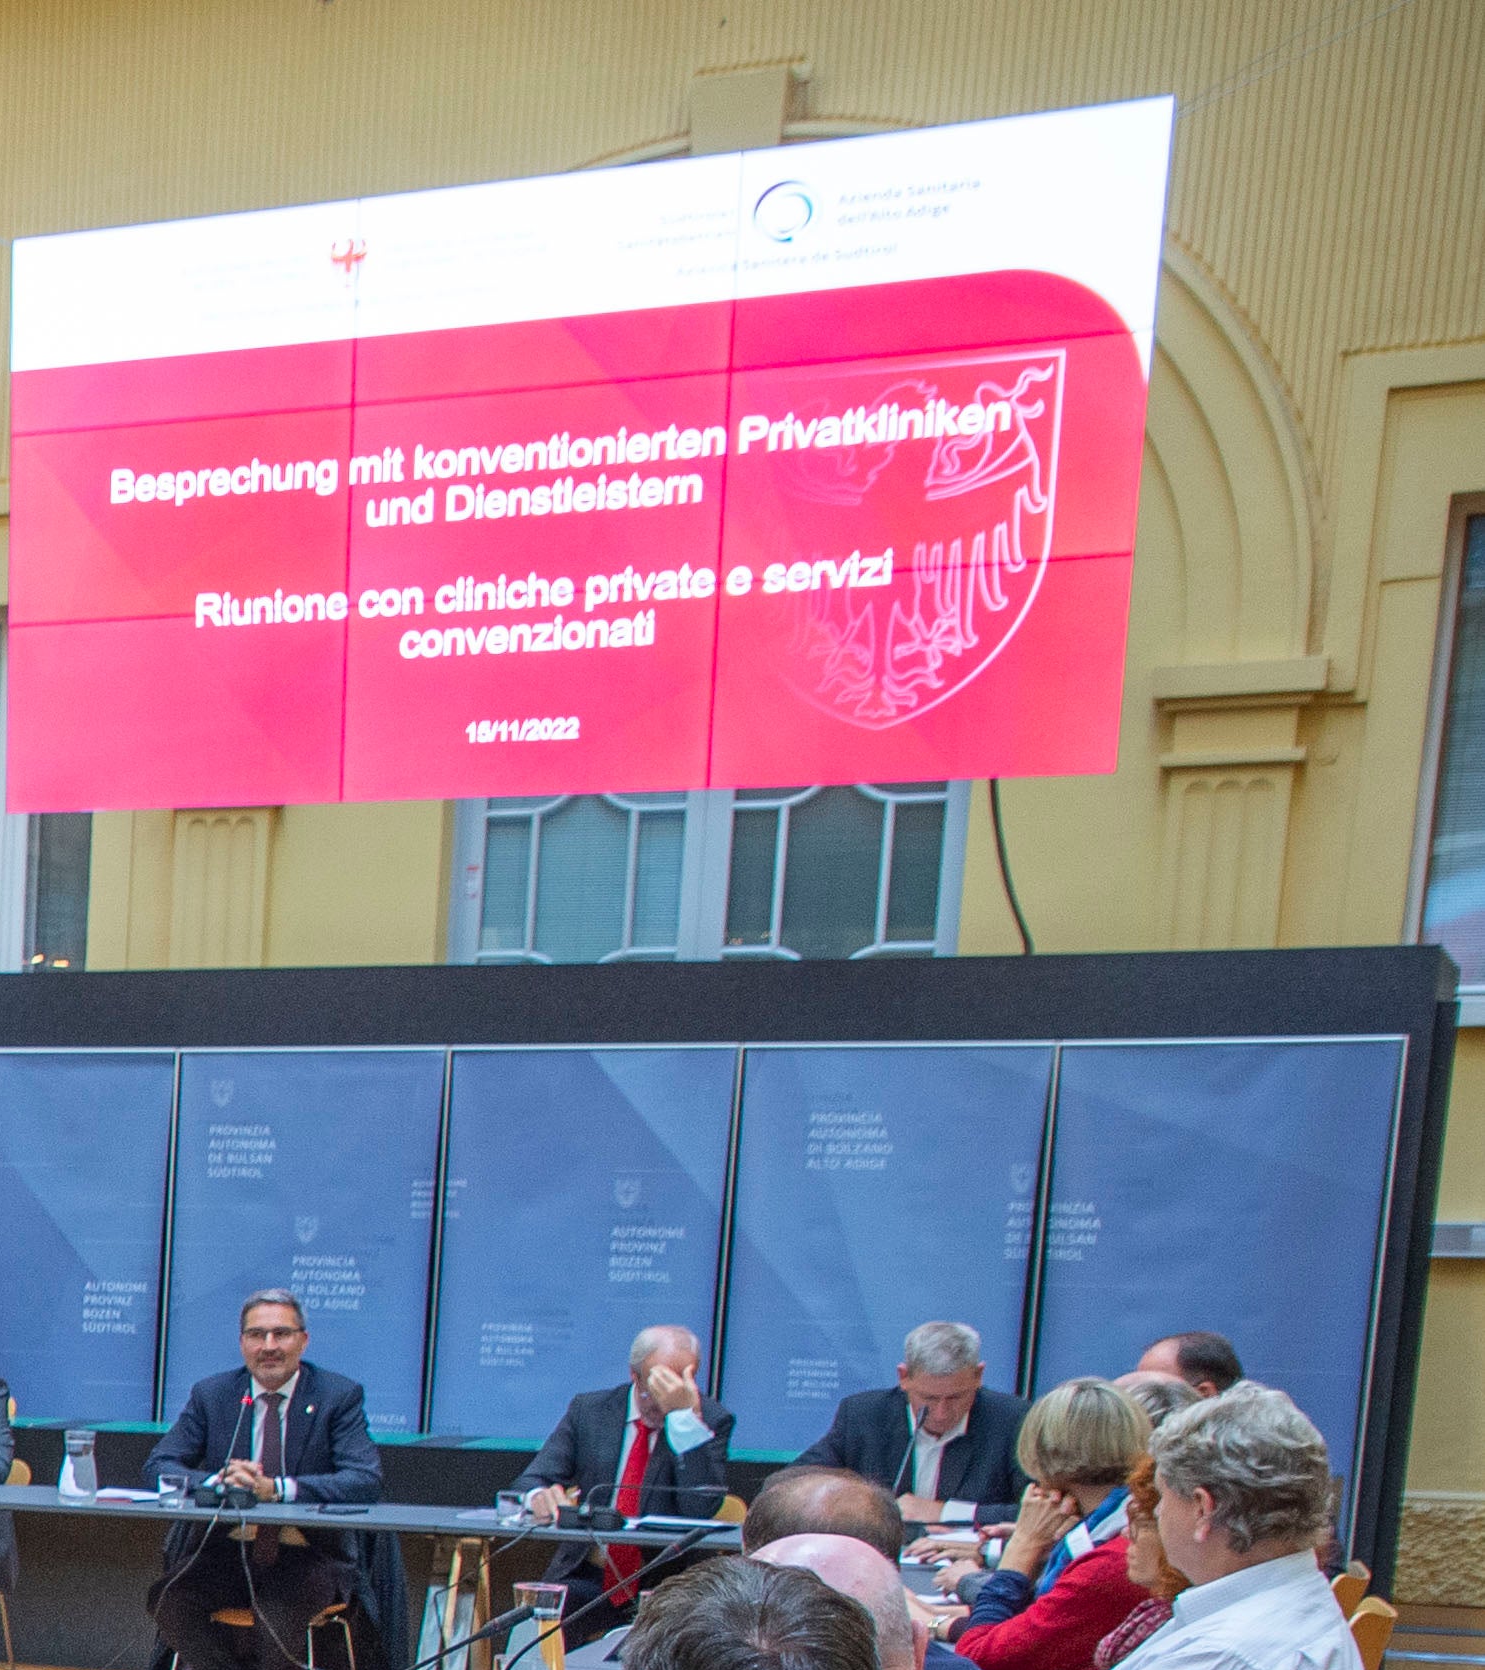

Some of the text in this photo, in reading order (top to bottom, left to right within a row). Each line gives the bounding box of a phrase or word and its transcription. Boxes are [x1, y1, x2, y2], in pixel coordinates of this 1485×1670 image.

[110, 398, 1012, 507] Besprechung mit konventionierten Privatkliniken
[366, 472, 704, 528] und Dienstleistern
[195, 547, 894, 628] Riunione con cliniche private e servizi
[399, 608, 655, 659] convenzionati
